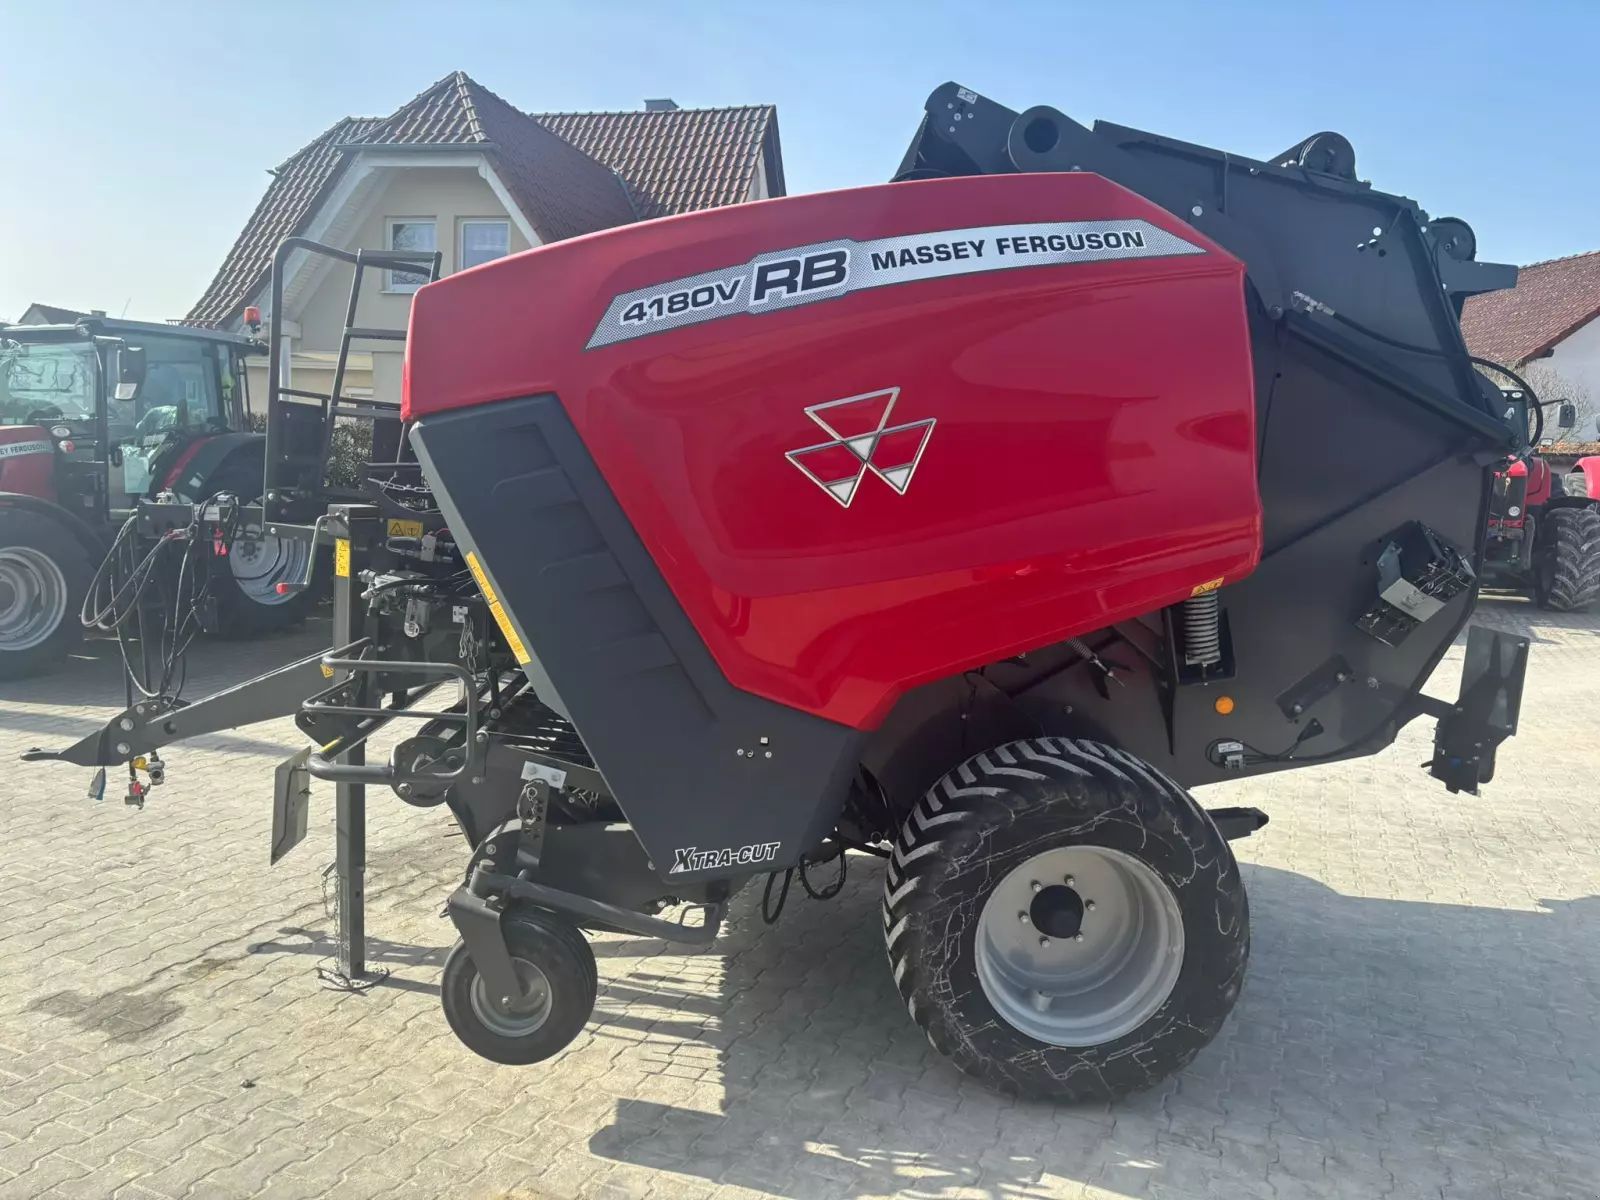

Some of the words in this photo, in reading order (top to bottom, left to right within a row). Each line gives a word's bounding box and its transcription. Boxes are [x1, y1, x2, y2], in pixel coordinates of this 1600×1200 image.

[623, 280, 740, 322] 4180V
[753, 250, 847, 301] RB
[871, 239, 985, 271] MASSEY
[996, 231, 1144, 255] FERGUSON
[669, 842, 781, 874] XTRA-CUT
